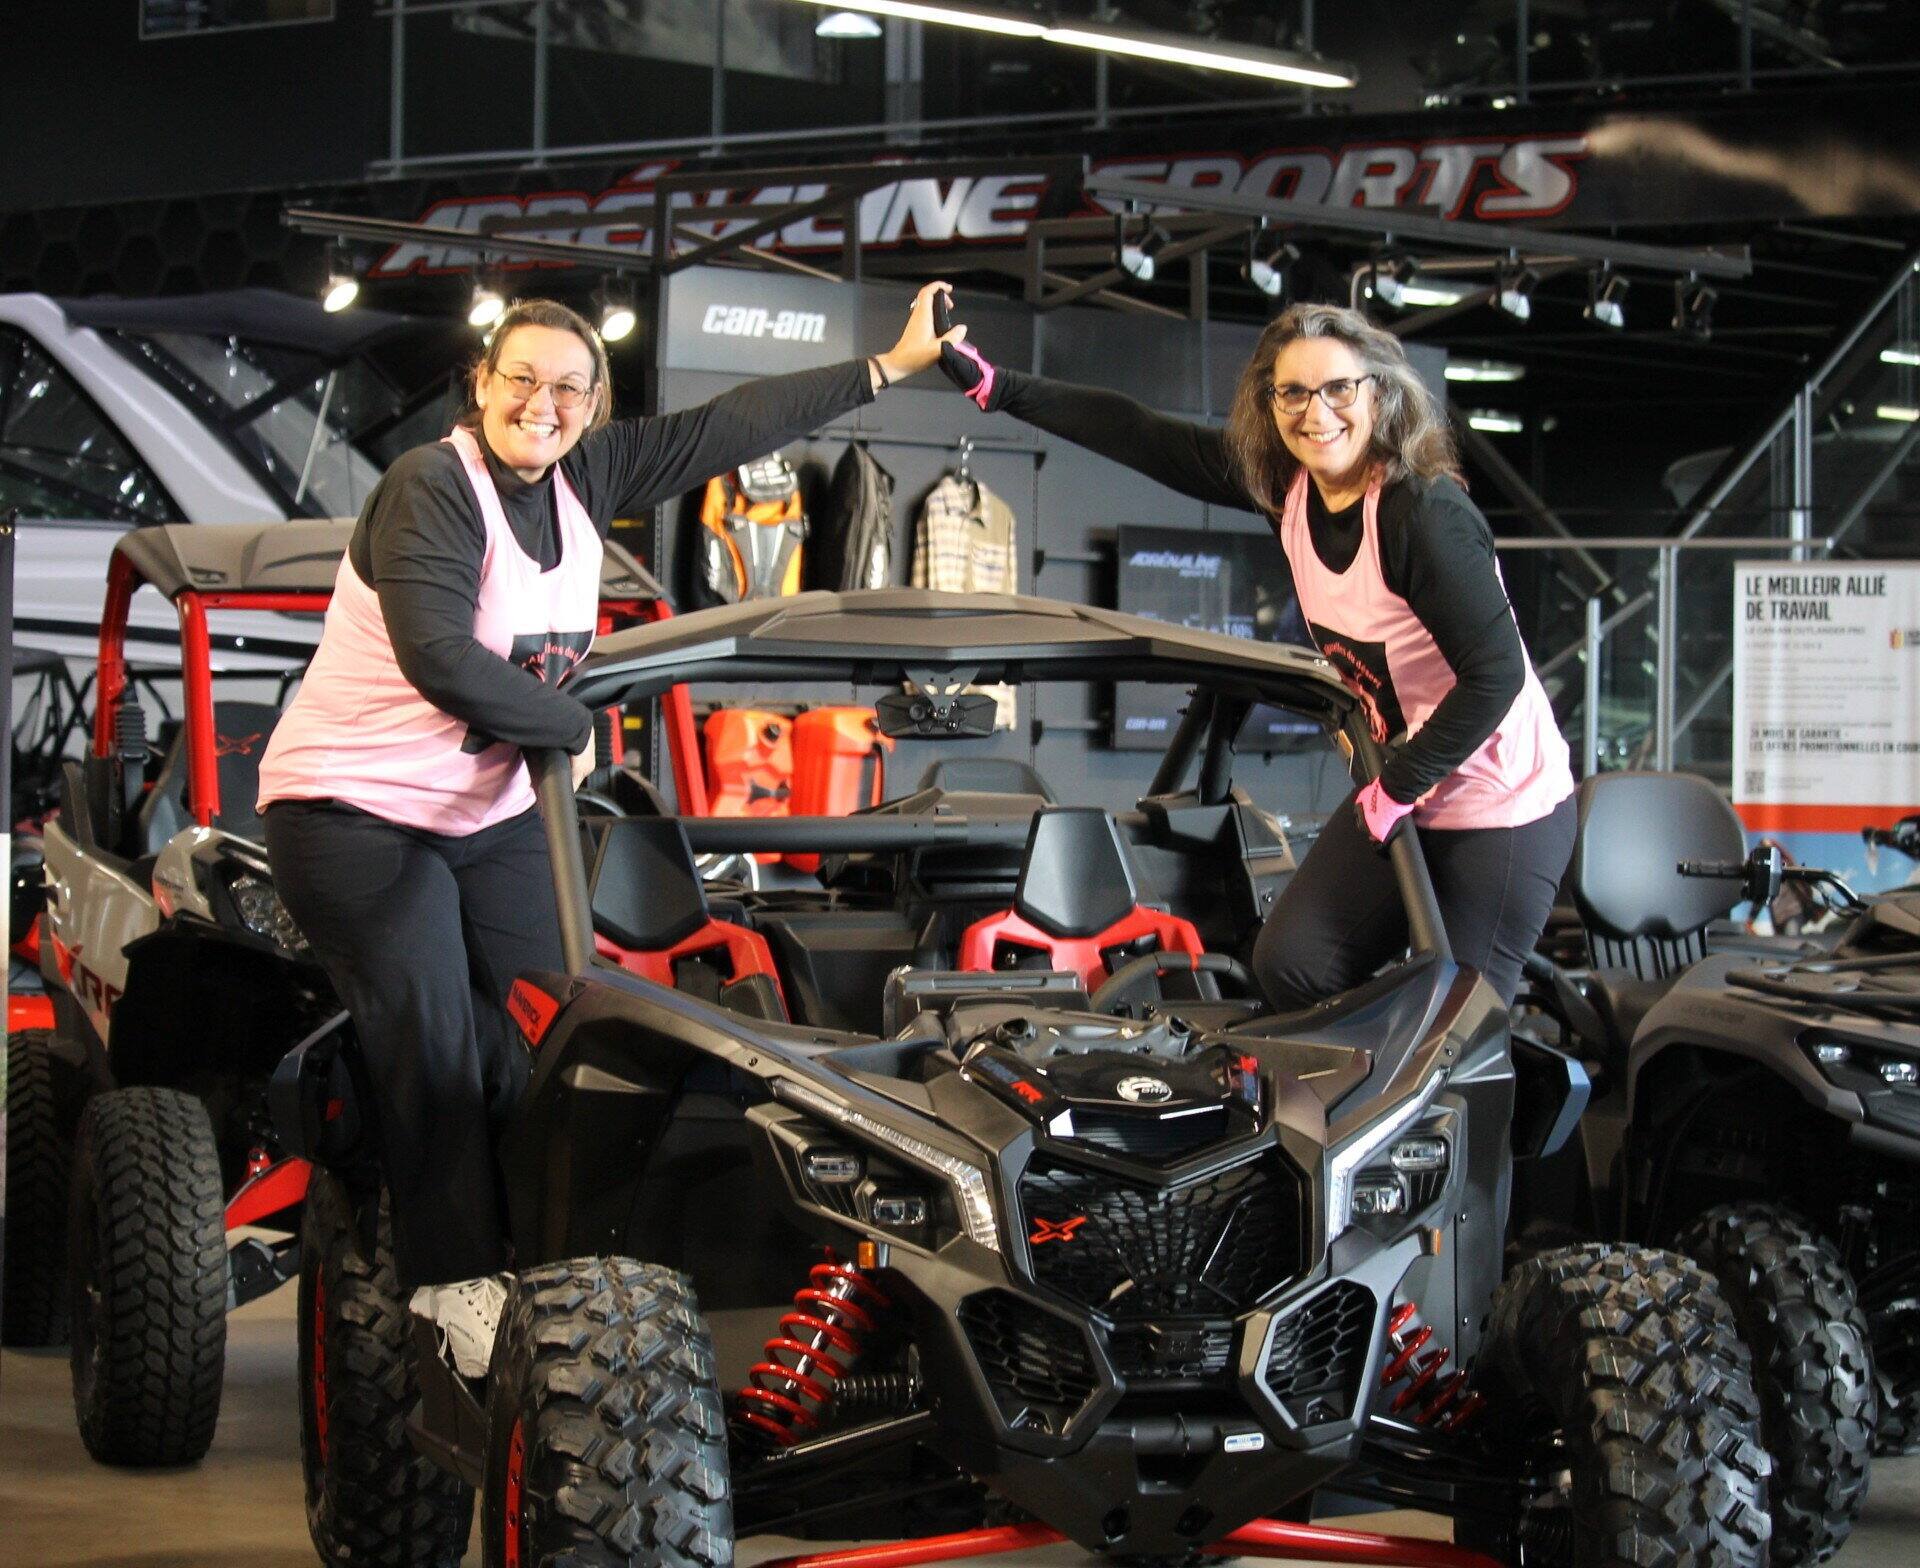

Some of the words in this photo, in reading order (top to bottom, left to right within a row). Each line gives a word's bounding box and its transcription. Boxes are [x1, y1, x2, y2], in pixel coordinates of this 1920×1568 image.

[1086, 137, 1586, 219] SPORTS
[702, 304, 826, 342] can-am
[1746, 576, 1762, 596] LE
[1768, 576, 1841, 596] MEILLEUR
[1846, 573, 1886, 596] ALLIÉ
[1746, 601, 1763, 620] DE
[1771, 601, 1831, 620] TRAVAIL
